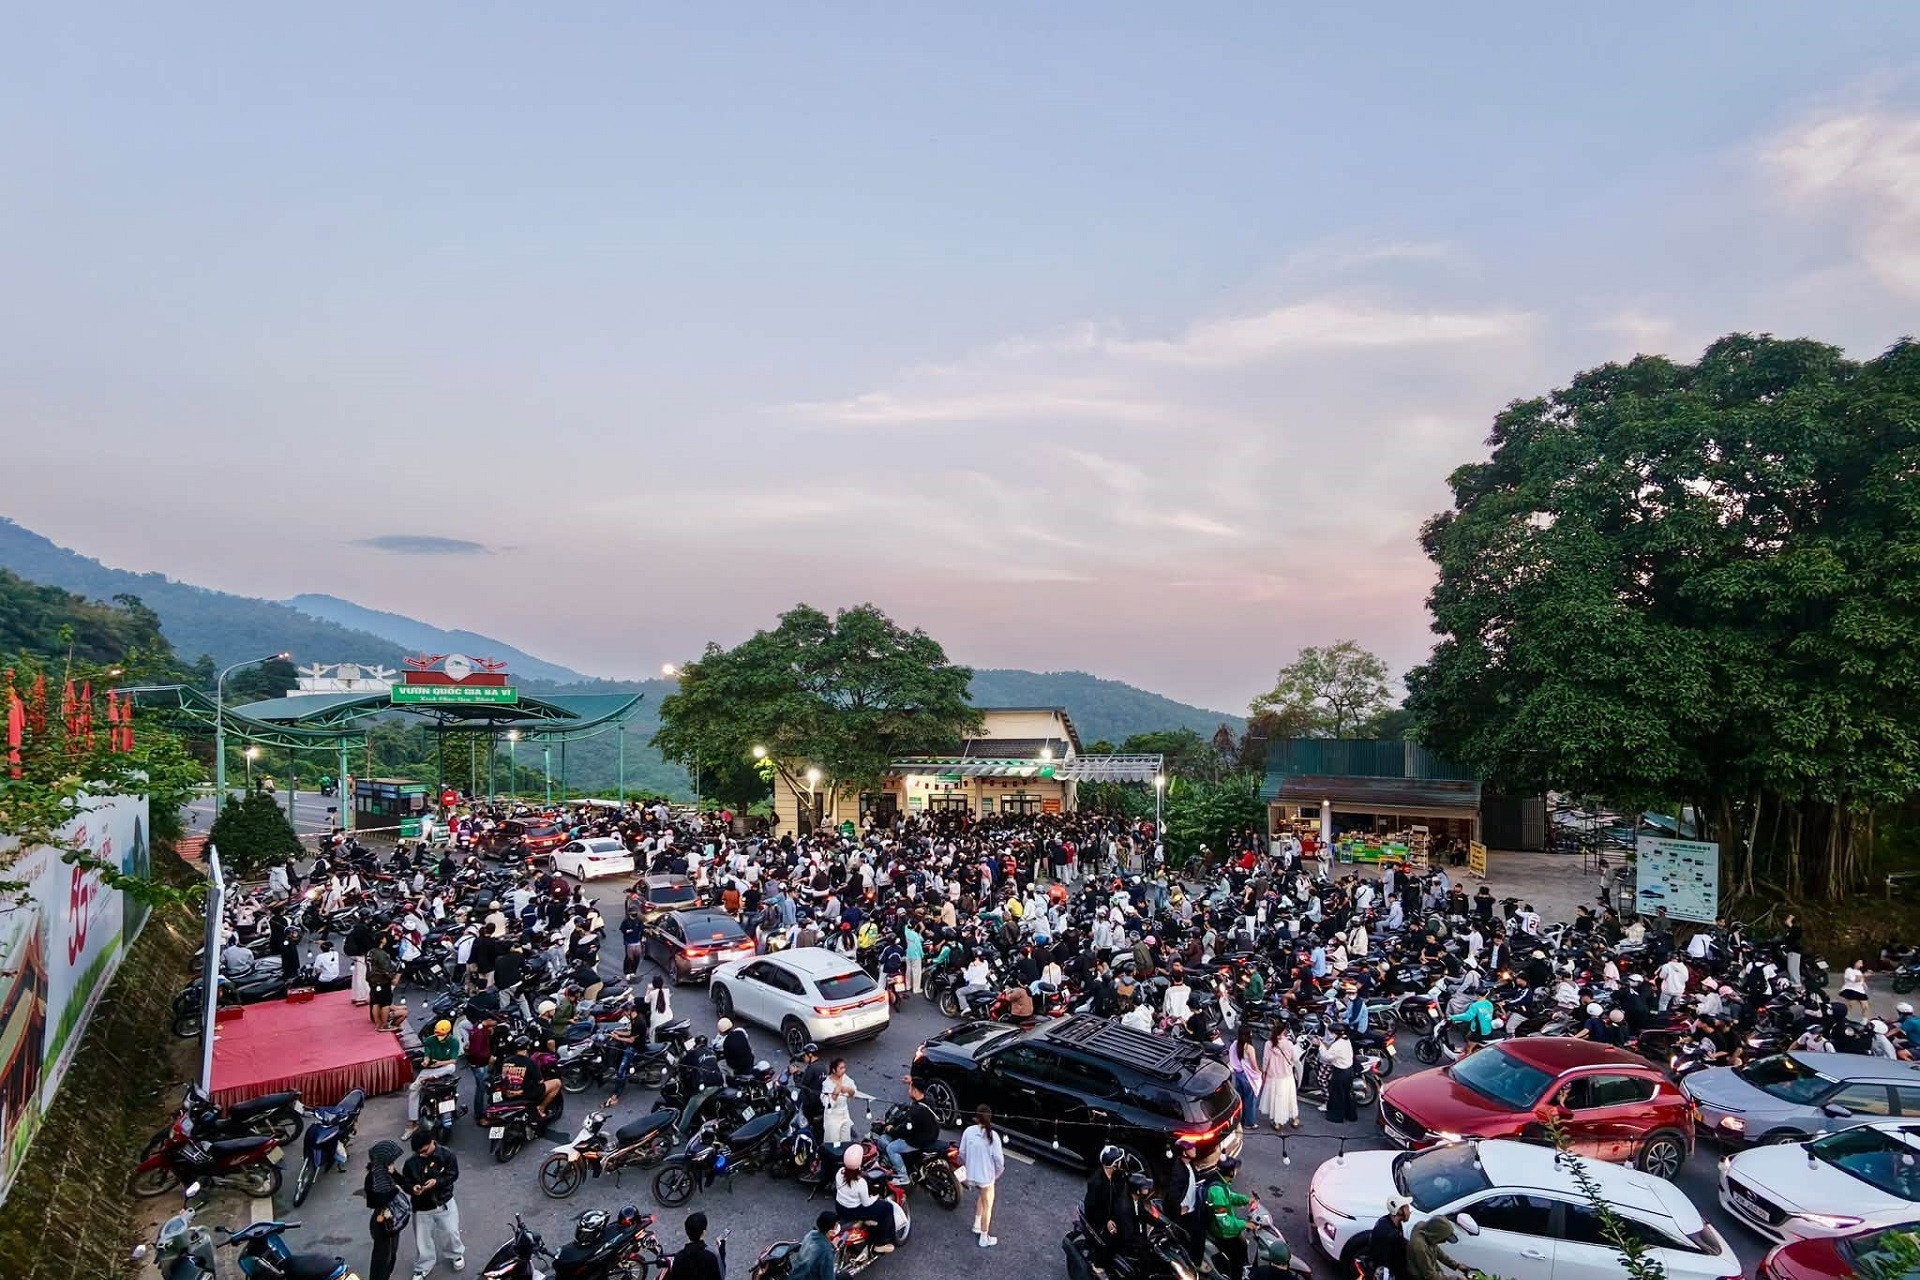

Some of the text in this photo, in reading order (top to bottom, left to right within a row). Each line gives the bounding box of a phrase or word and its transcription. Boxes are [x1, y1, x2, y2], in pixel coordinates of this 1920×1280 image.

[464, 688, 482, 696] GIA
[484, 688, 499, 696] BA
[68, 865, 89, 967] 5G
